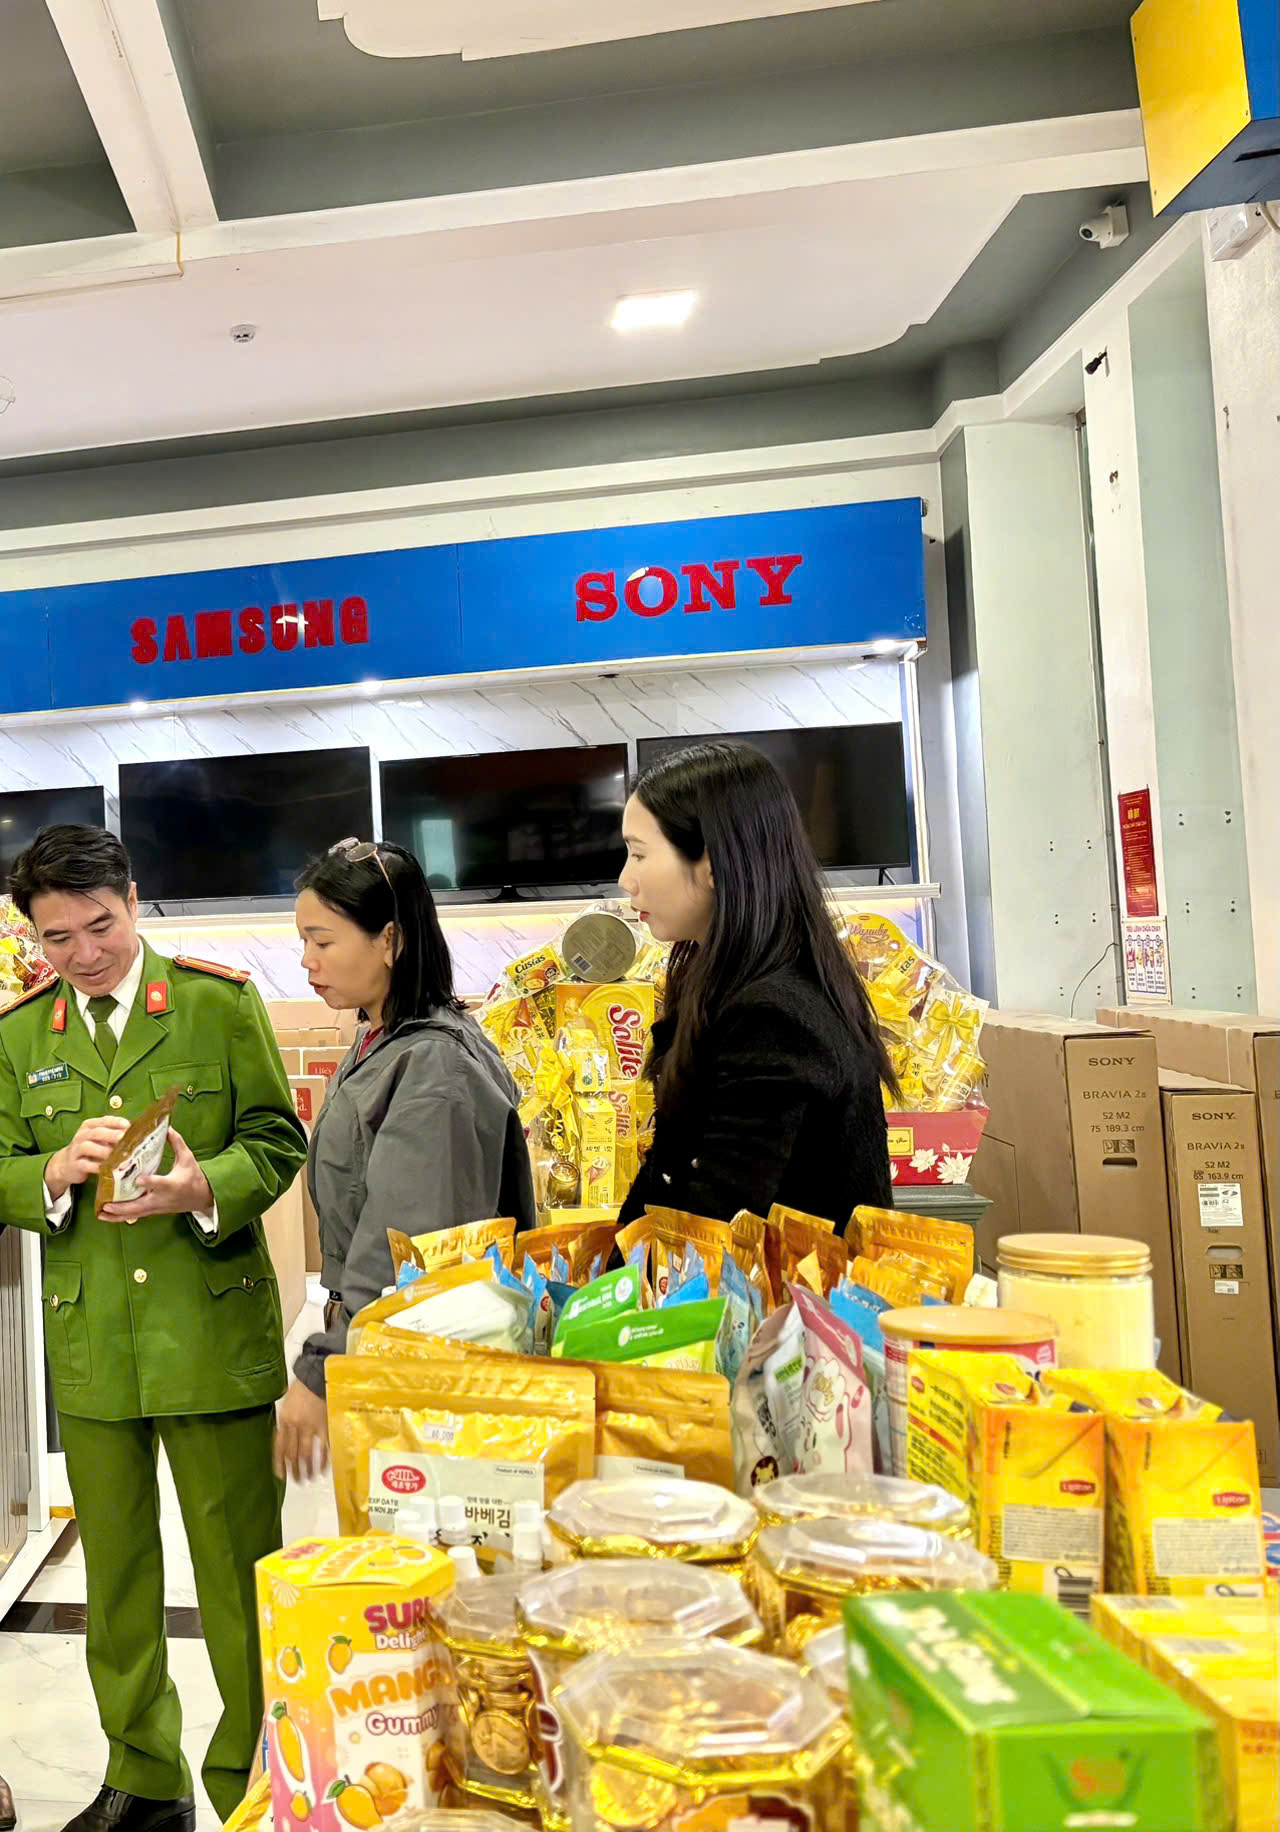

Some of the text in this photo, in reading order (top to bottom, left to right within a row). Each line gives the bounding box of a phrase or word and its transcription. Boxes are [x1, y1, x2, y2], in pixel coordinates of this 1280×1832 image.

[575, 555, 804, 622] SONY
[130, 597, 369, 665] SAMSUNG
[514, 952, 546, 976] Custas
[607, 1003, 647, 1080] Solite
[1088, 1057, 1135, 1067] SONY
[1083, 1090, 1132, 1100] BRAVIA
[608, 1089, 633, 1140] Solite
[1102, 1112, 1131, 1120] S2 M2
[1191, 1112, 1234, 1121] SONY
[1090, 1125, 1101, 1134] 75
[1106, 1125, 1129, 1133] 189.3
[1187, 1142, 1231, 1151] BRAVIA
[1204, 1161, 1231, 1169] S2 M2
[1207, 1172, 1229, 1180] 163.9
[1062, 1483, 1092, 1493] Lipton
[367, 1498, 399, 1507] EXP DATE
[1216, 1494, 1247, 1505] Lipton
[374, 1506, 387, 1514] NOV
[464, 1506, 511, 1529] 바베김
[329, 1658, 442, 1718] MANG
[365, 1703, 440, 1737] Gummy
